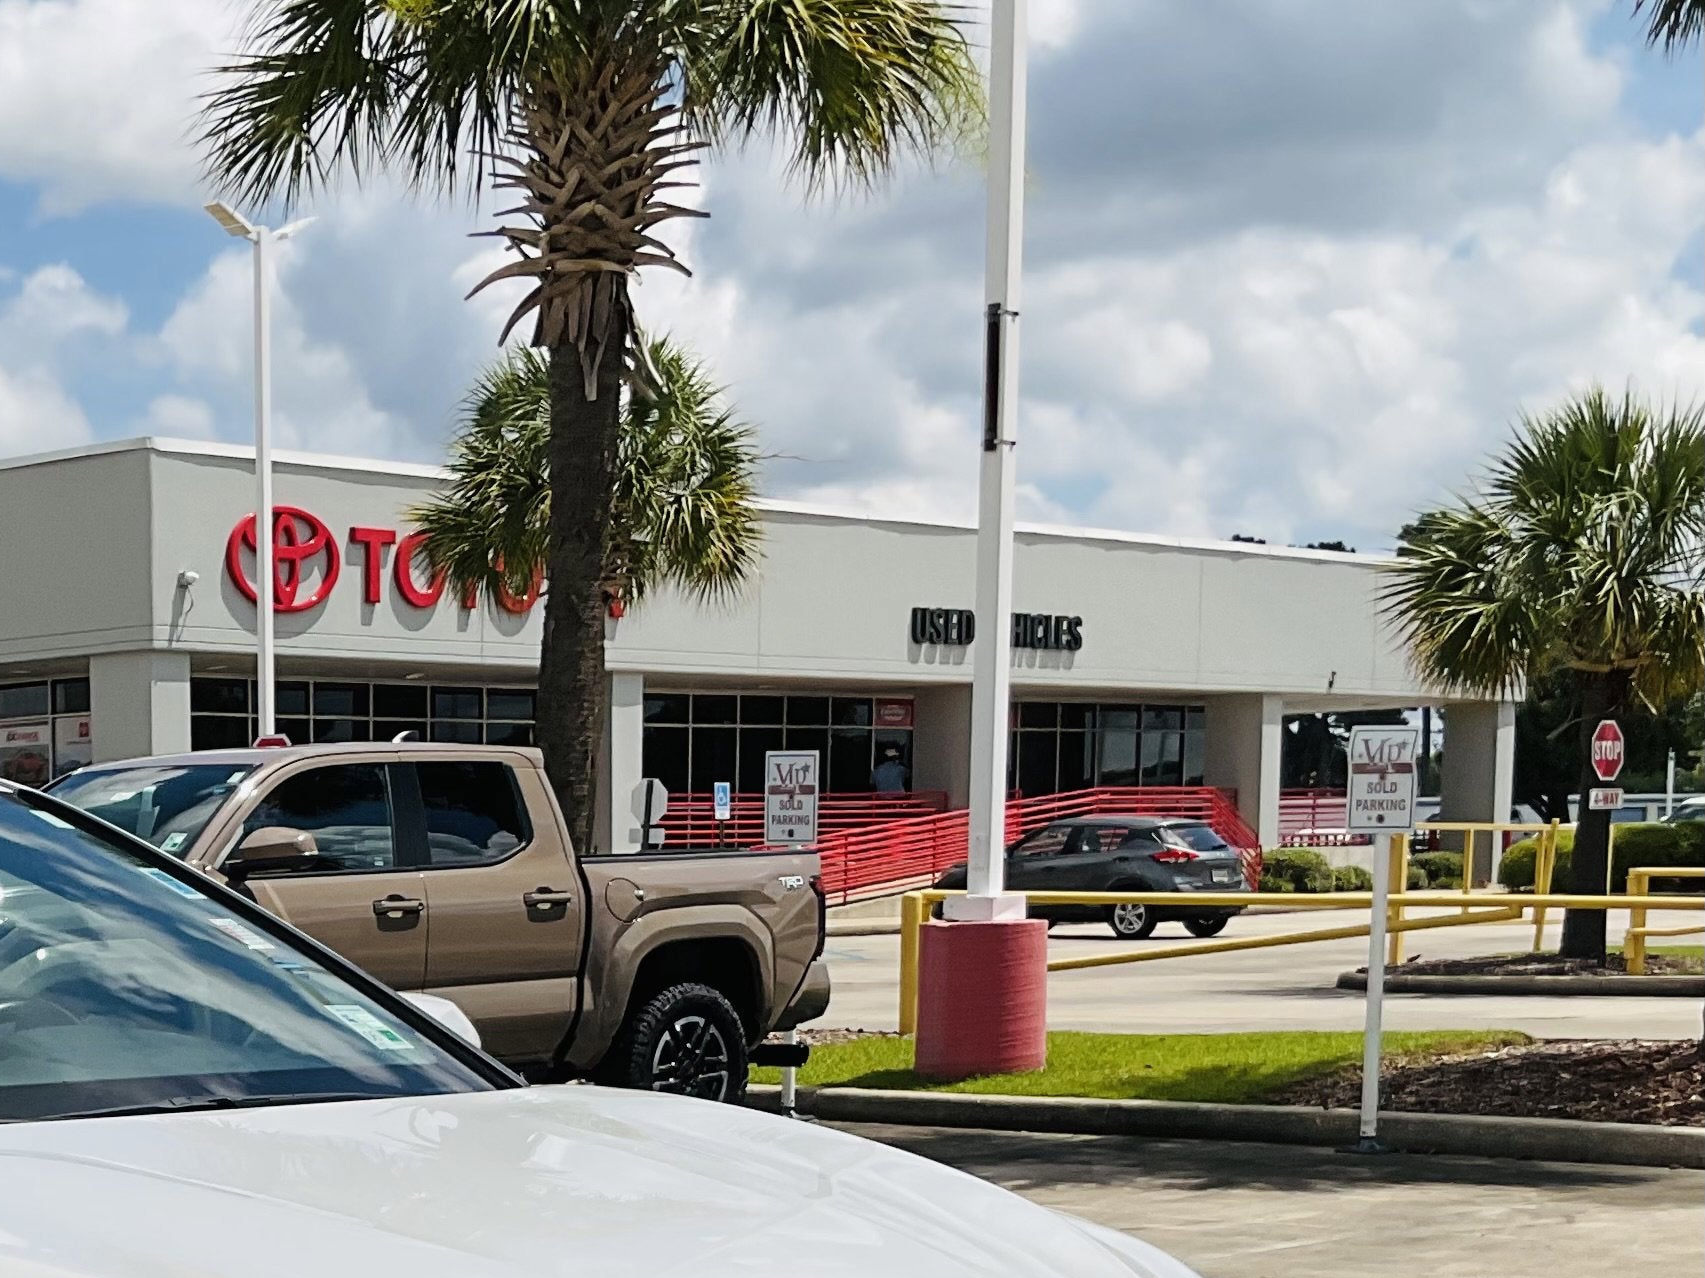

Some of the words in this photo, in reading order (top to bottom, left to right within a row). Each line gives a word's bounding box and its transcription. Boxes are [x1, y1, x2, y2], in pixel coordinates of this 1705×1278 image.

[911, 607, 976, 645] USED
[1010, 613, 1083, 650] HICLES
[1594, 740, 1621, 760] STOP
[1367, 782, 1397, 793] SOLD
[779, 800, 803, 810] SOLD
[1356, 799, 1406, 811] PARKING
[1594, 793, 1620, 805] 4-WAY
[772, 815, 809, 825] PARKING
[778, 876, 804, 888] TRD
